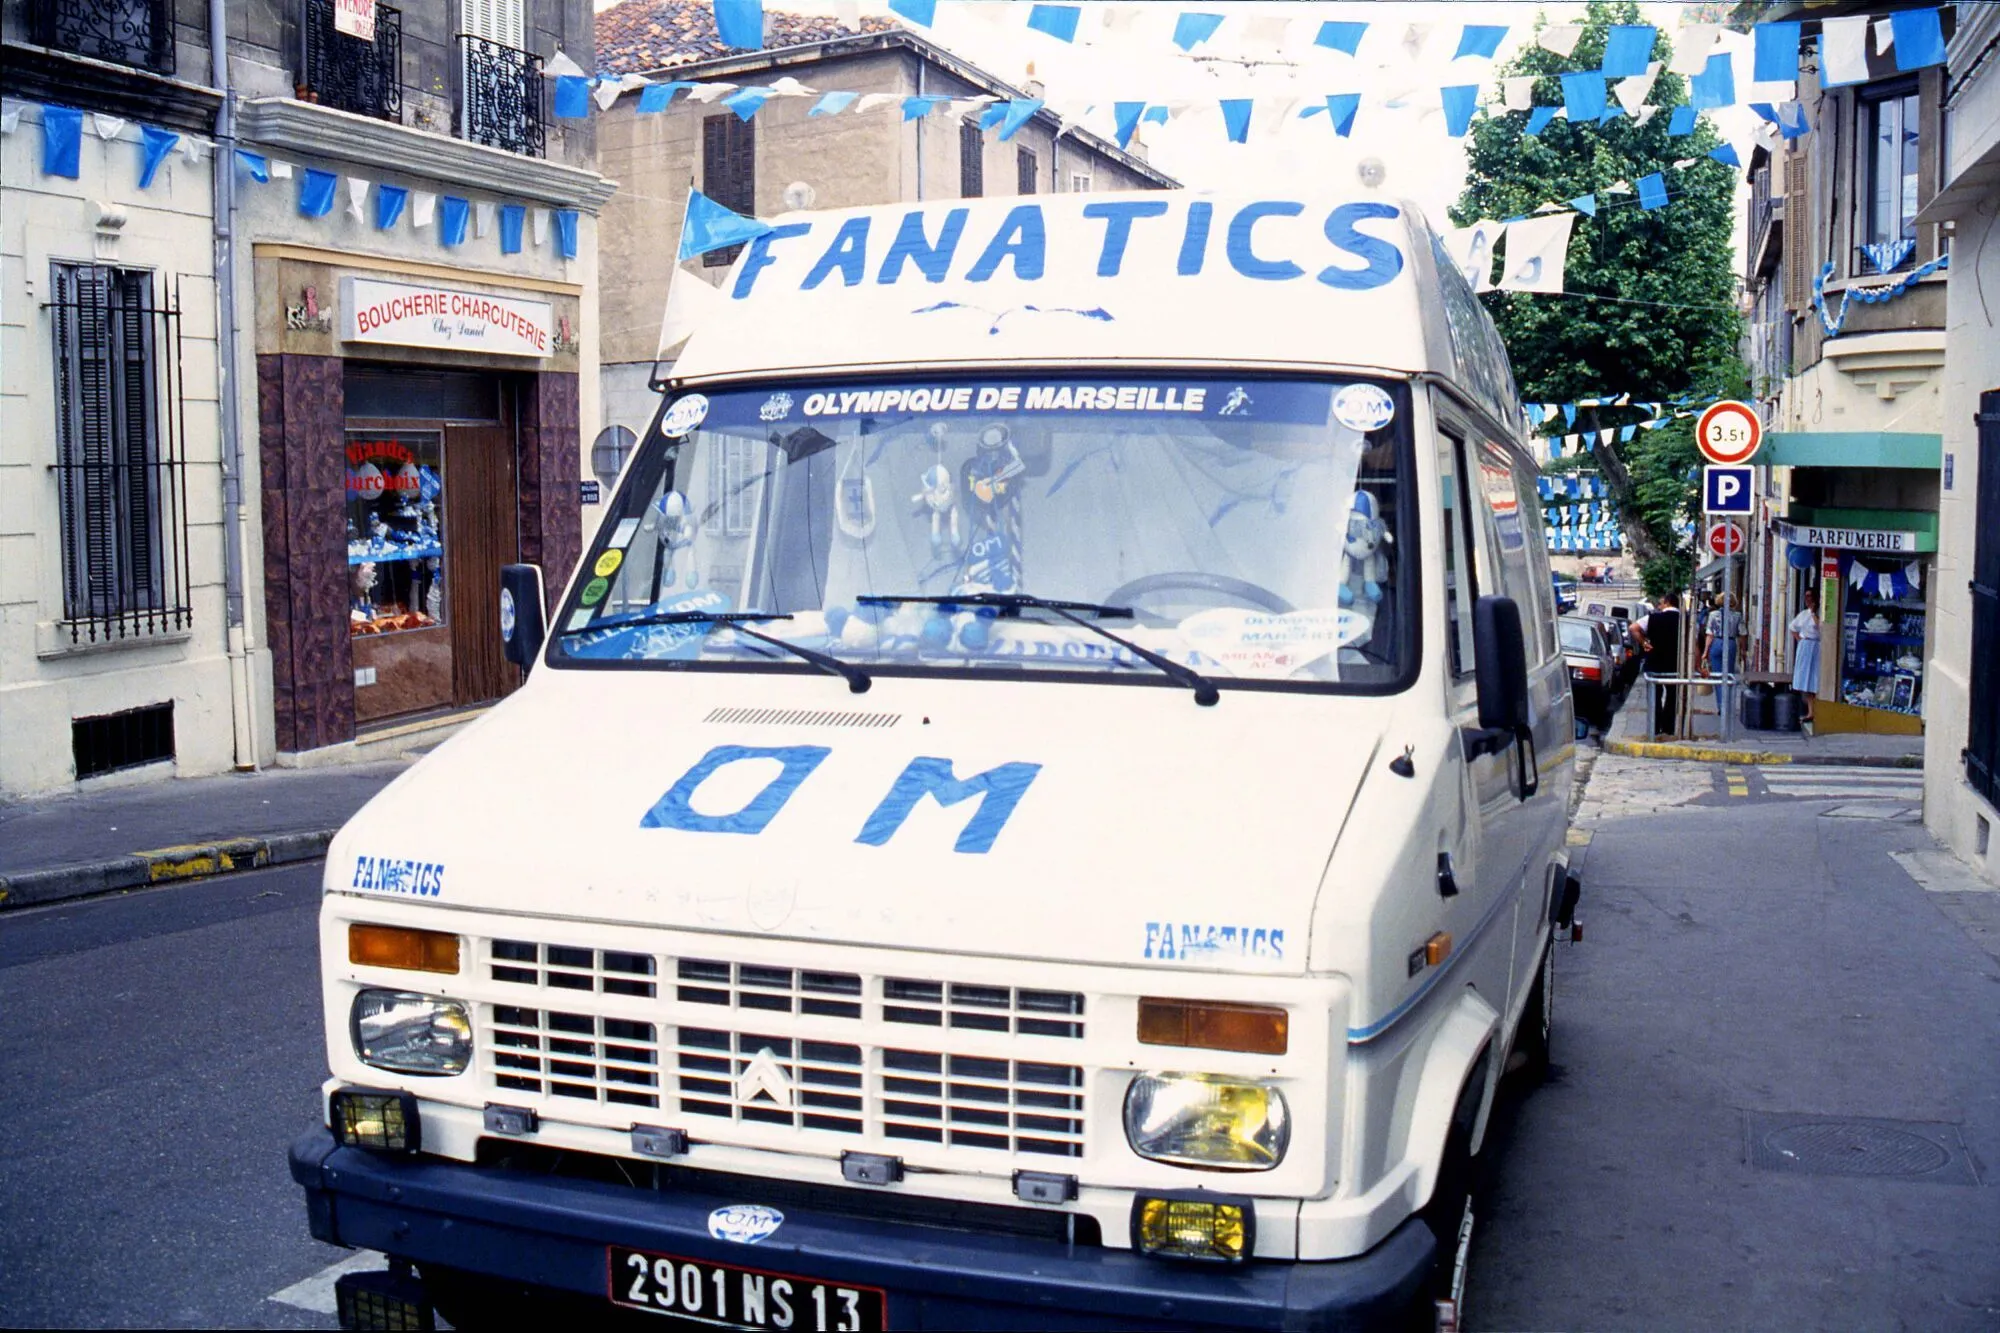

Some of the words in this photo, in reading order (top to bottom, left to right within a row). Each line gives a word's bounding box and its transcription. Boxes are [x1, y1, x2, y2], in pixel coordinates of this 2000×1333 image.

[731, 200, 1404, 300] FANATICS
[357, 294, 447, 334] BOUCHERIE
[452, 295, 547, 351] CHARCUTERIE
[432, 317, 452, 340] Chez
[457, 320, 486, 337] Daniel
[803, 388, 972, 416] OLYMPIQUE
[975, 387, 1021, 410] DE
[1024, 387, 1206, 412] MARSEILLE
[1718, 475, 1740, 505] P
[972, 536, 1002, 557] OM
[1808, 528, 1902, 550] PARFUMERIE
[726, 1211, 770, 1229] OM
[627, 1253, 726, 1318] 2901
[742, 1272, 794, 1328] NS
[811, 1284, 860, 1331] 13
